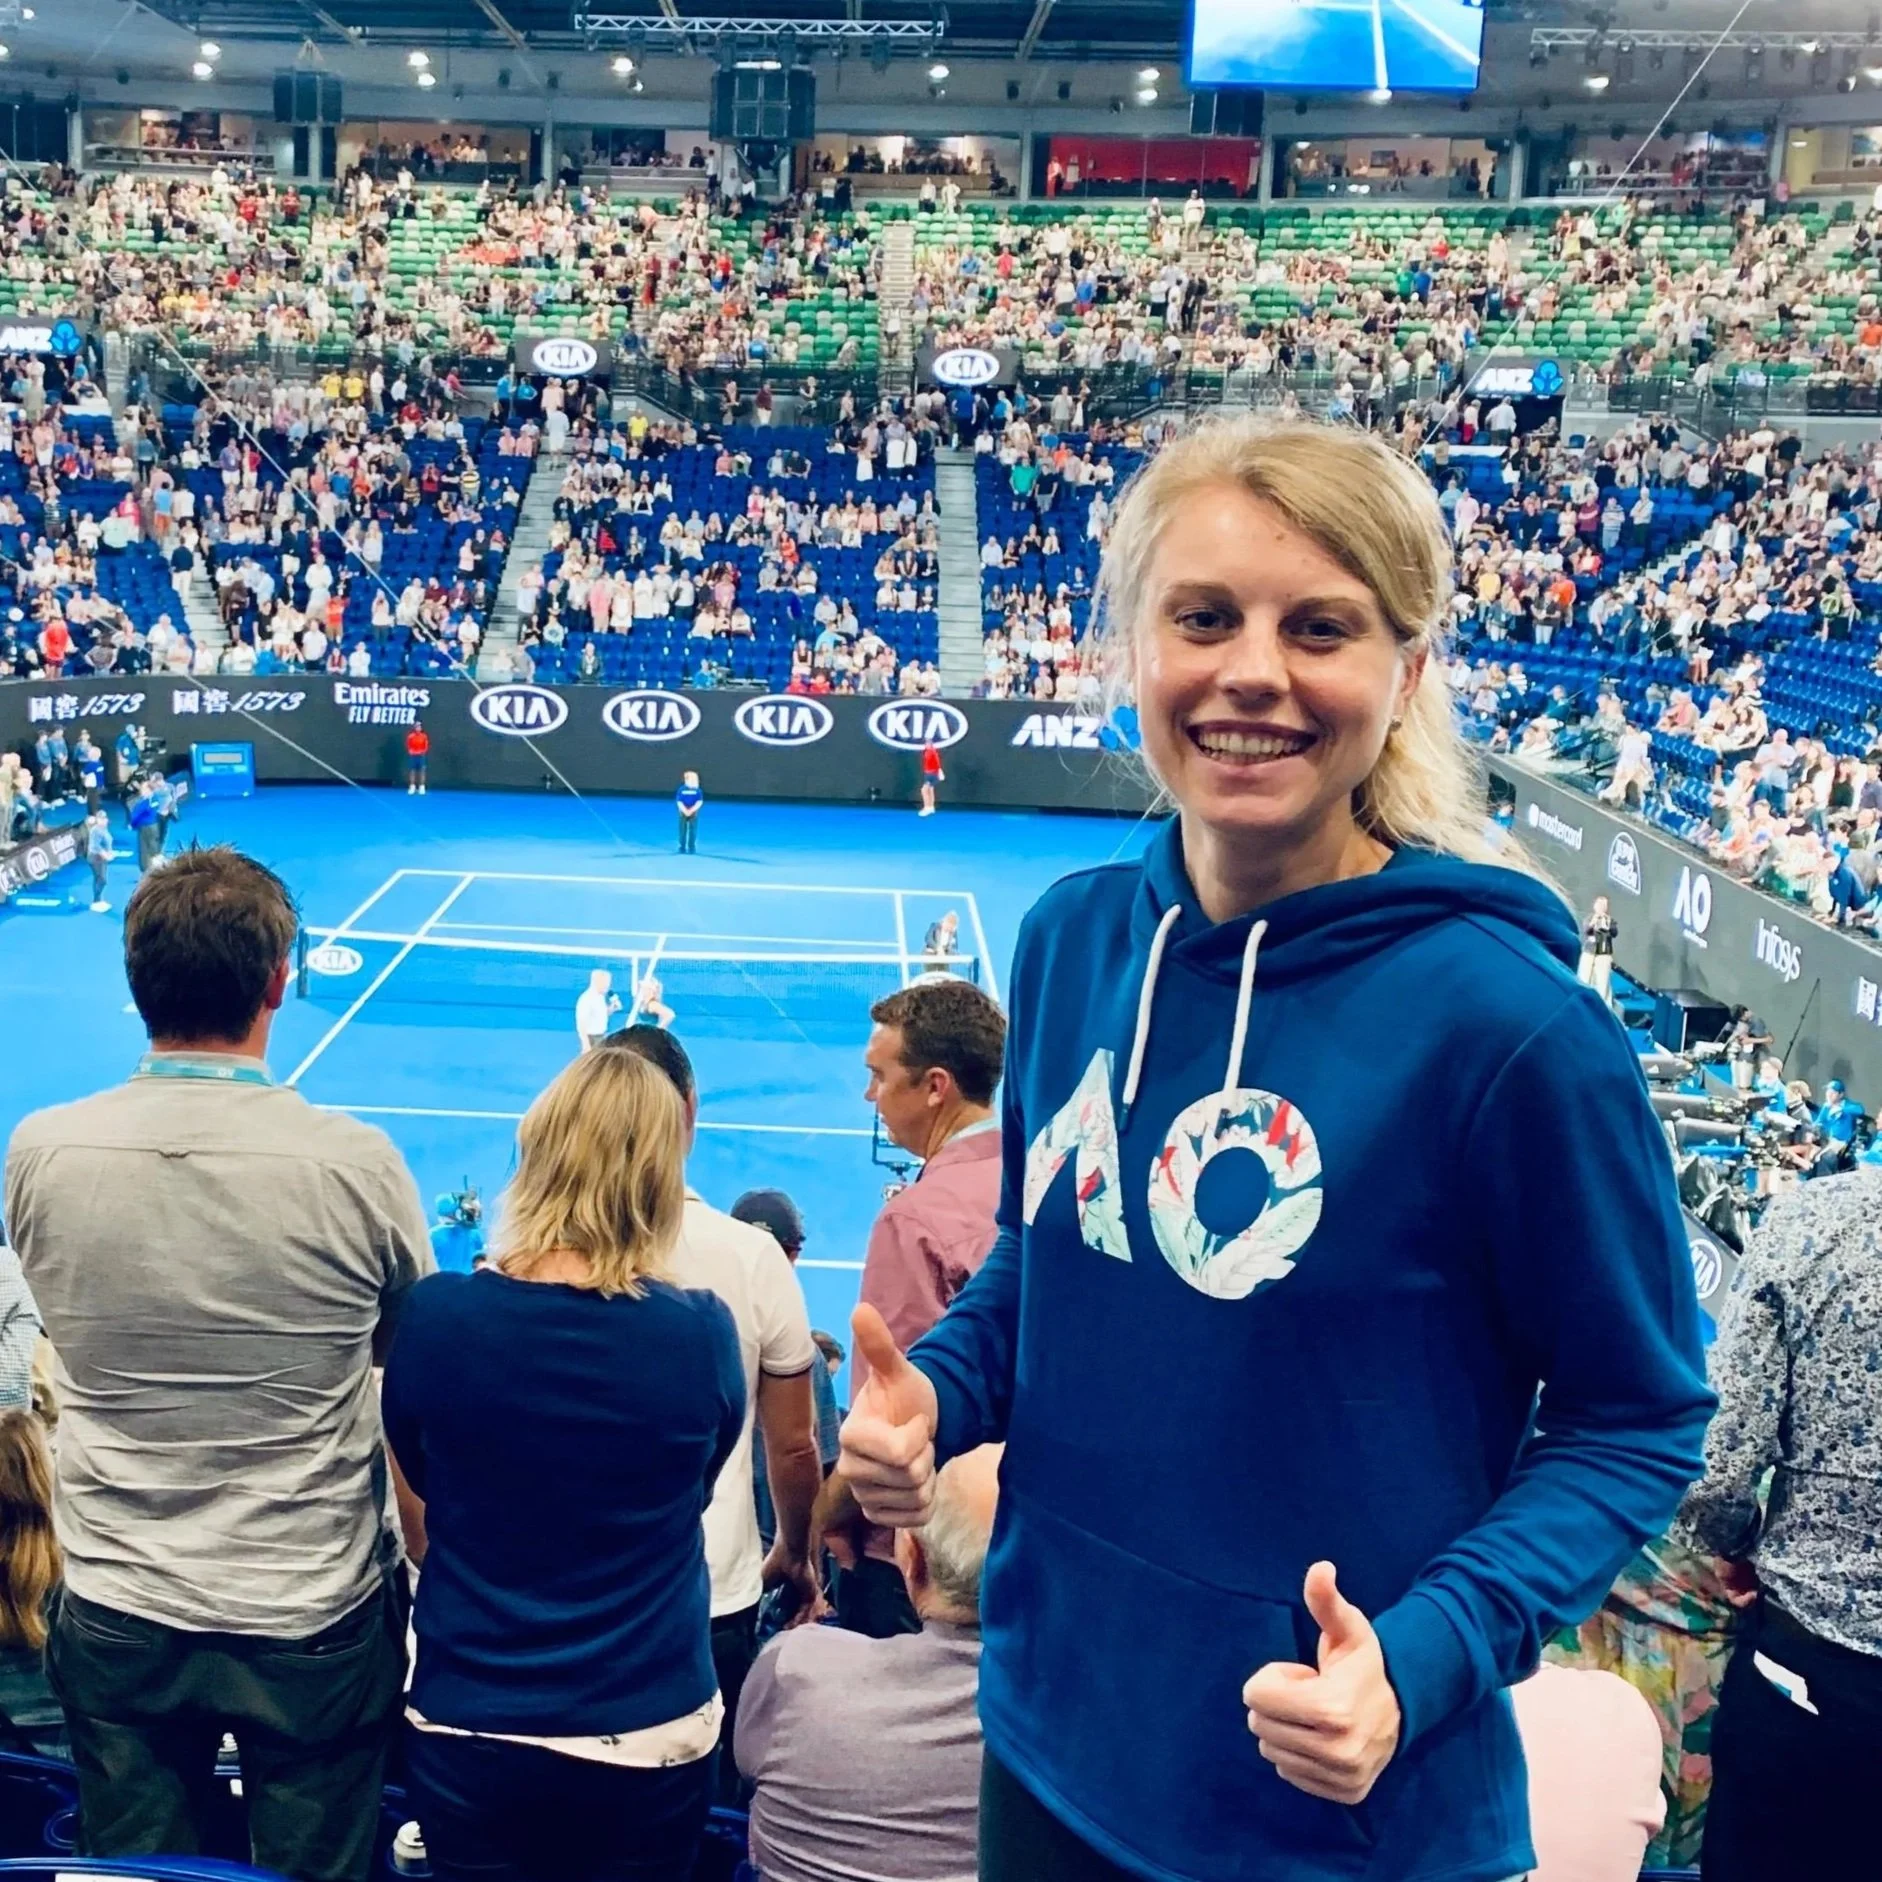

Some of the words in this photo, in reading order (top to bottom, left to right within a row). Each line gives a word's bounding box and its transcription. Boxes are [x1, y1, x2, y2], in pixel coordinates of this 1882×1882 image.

[334, 682, 430, 707] Emirates
[488, 695, 551, 724] KIA
[348, 705, 371, 724] FLY
[371, 706, 416, 725] BETTER
[620, 700, 684, 730] KIA
[752, 705, 816, 735] KIA
[886, 710, 950, 740] KIA
[1011, 714, 1100, 748] ANZ
[1539, 810, 1583, 851] mastercard
[1757, 918, 1801, 983] Infosys
